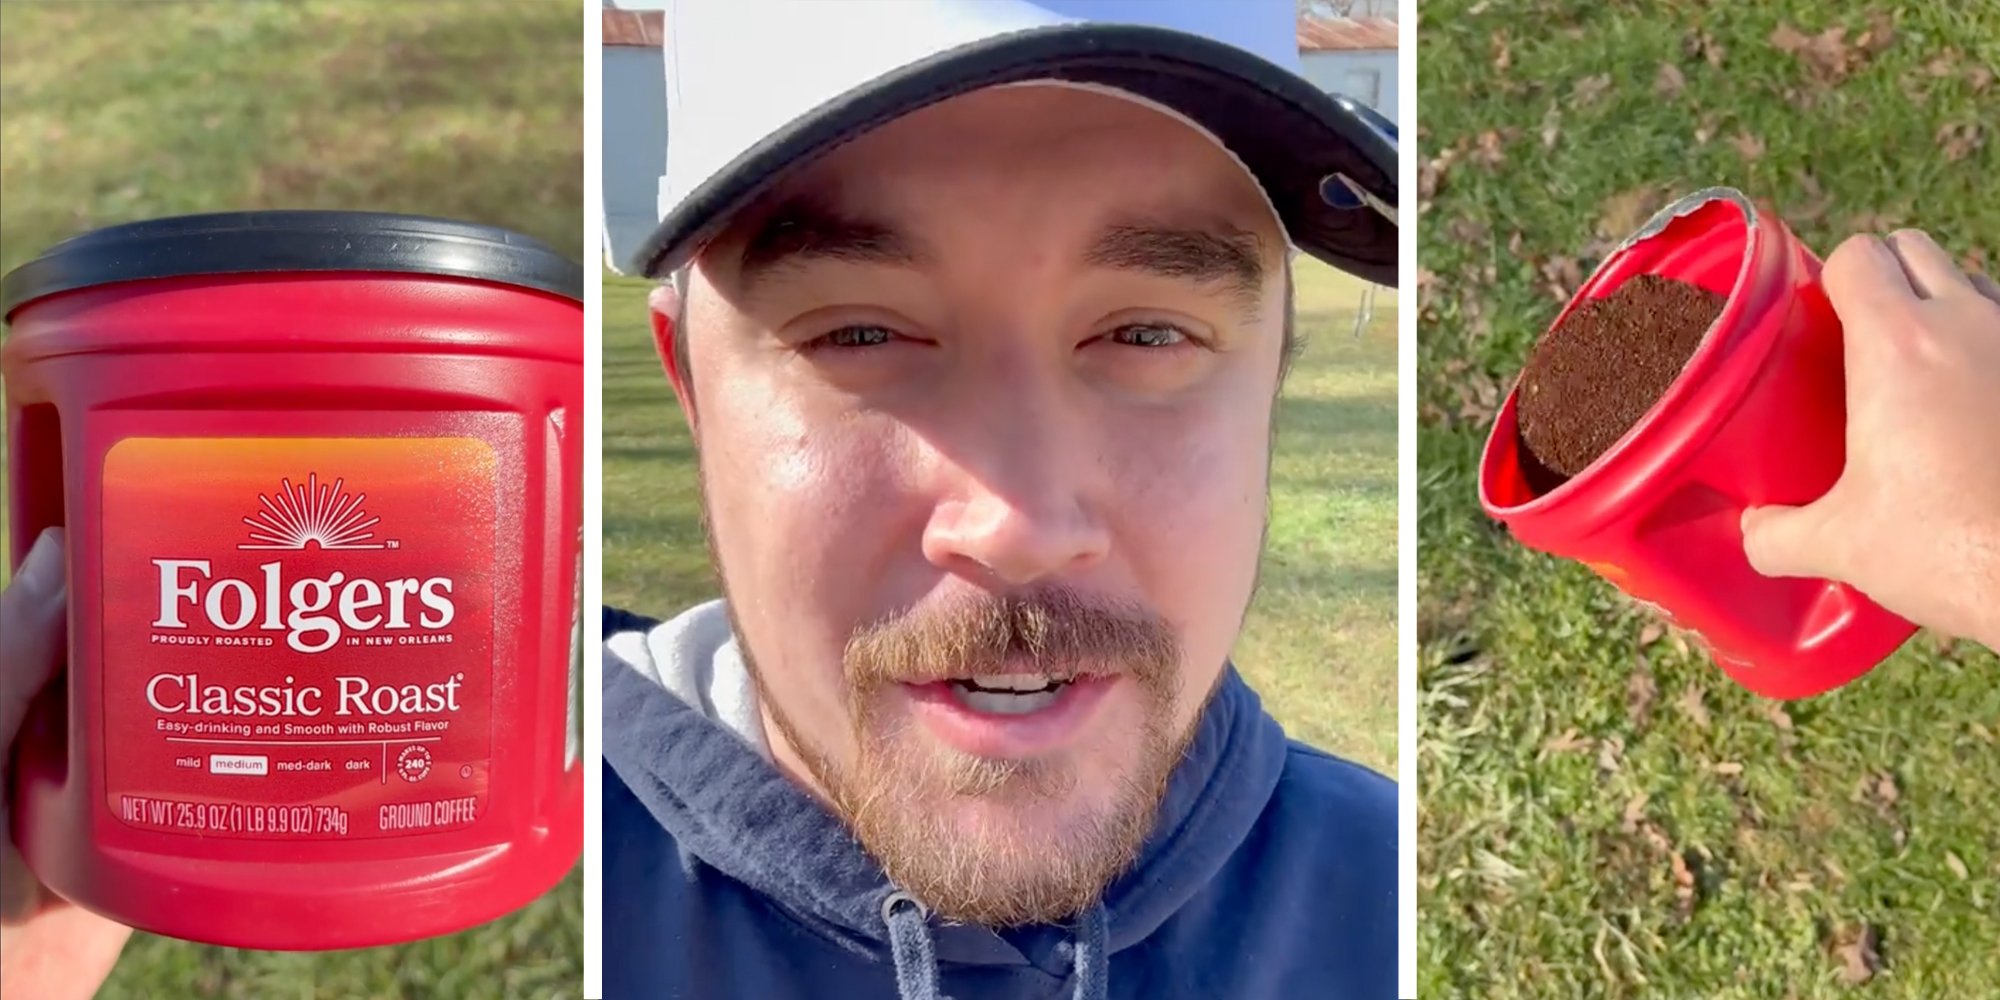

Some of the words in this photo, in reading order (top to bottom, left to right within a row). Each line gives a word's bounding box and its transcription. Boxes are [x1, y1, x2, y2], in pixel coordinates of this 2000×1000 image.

[151, 559, 455, 653] Folgers
[151, 634, 210, 645] PROUDLY
[215, 637, 273, 646] ROASTED
[346, 637, 360, 645] IN
[366, 636, 393, 645] NEW
[399, 634, 453, 644] ORLEANS
[146, 673, 322, 716] Classic
[335, 674, 461, 715] Roast
[157, 719, 251, 735] Easy-drinking
[256, 724, 280, 734] and
[284, 724, 334, 735] Smooth
[338, 723, 364, 734] with
[368, 722, 411, 733] Robust
[414, 720, 449, 732] Flavor
[176, 758, 201, 768] mild
[215, 759, 263, 770] medium
[277, 760, 332, 771] med-dark
[345, 760, 370, 770] dark
[404, 758, 425, 769] 240
[122, 796, 147, 822] NET
[149, 800, 174, 825] WT
[177, 802, 206, 829] 25.9
[208, 805, 228, 830] OZ
[230, 804, 242, 832] (1
[246, 806, 264, 832] LB
[267, 807, 288, 832] 9.9
[291, 806, 313, 834] OZ)
[315, 807, 348, 835] 734g
[379, 802, 432, 830] GROUND
[434, 797, 476, 825] COFFEE
